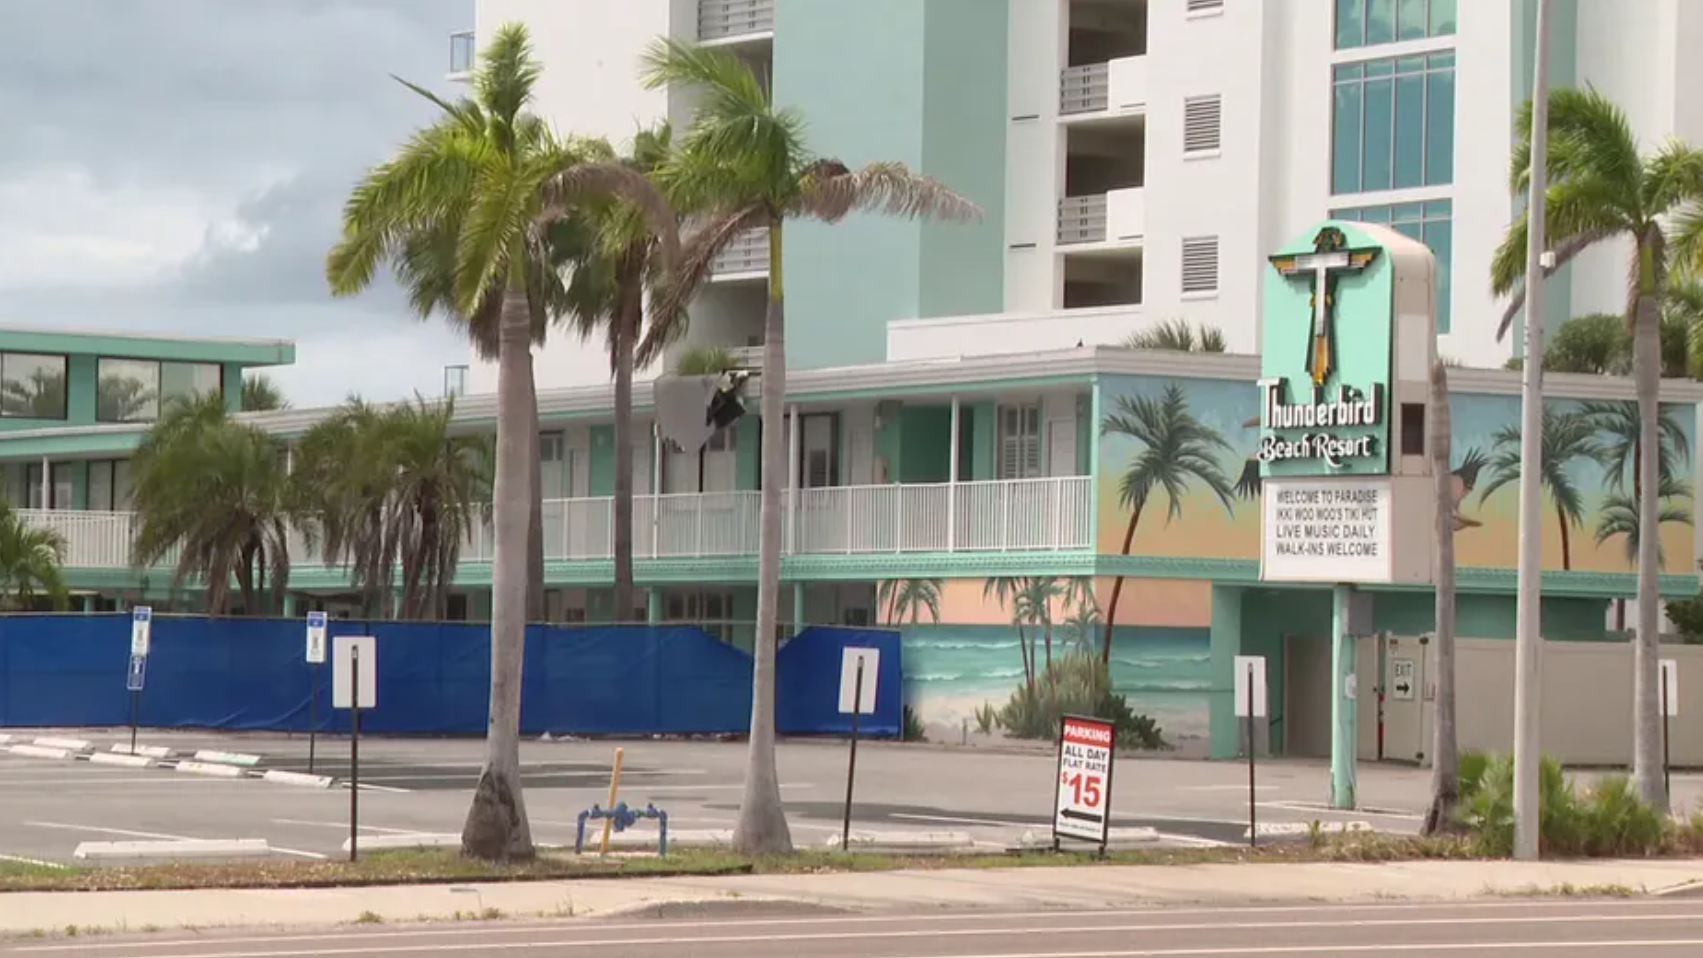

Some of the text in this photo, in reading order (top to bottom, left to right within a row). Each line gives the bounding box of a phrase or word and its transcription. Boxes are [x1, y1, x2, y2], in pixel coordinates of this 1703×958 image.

[1257, 378, 1379, 428] Thunderbird
[1257, 433, 1371, 467] Beach Resort
[1277, 490, 1377, 503] WELCOME TO PARADISE
[1295, 508, 1314, 520] WOO
[1345, 508, 1359, 520] TIKI
[1361, 508, 1377, 520] HUT
[1276, 525, 1375, 538] LIVE MUSIC DAILY
[1276, 542, 1377, 556] WALK-INS WELCOME
[1395, 663, 1412, 677] EXIT
[1063, 724, 1111, 742] PARKING
[1064, 745, 1107, 761] ALL DAY
[1063, 758, 1106, 773] FLAT RATE
[1062, 772, 1101, 807] $15
